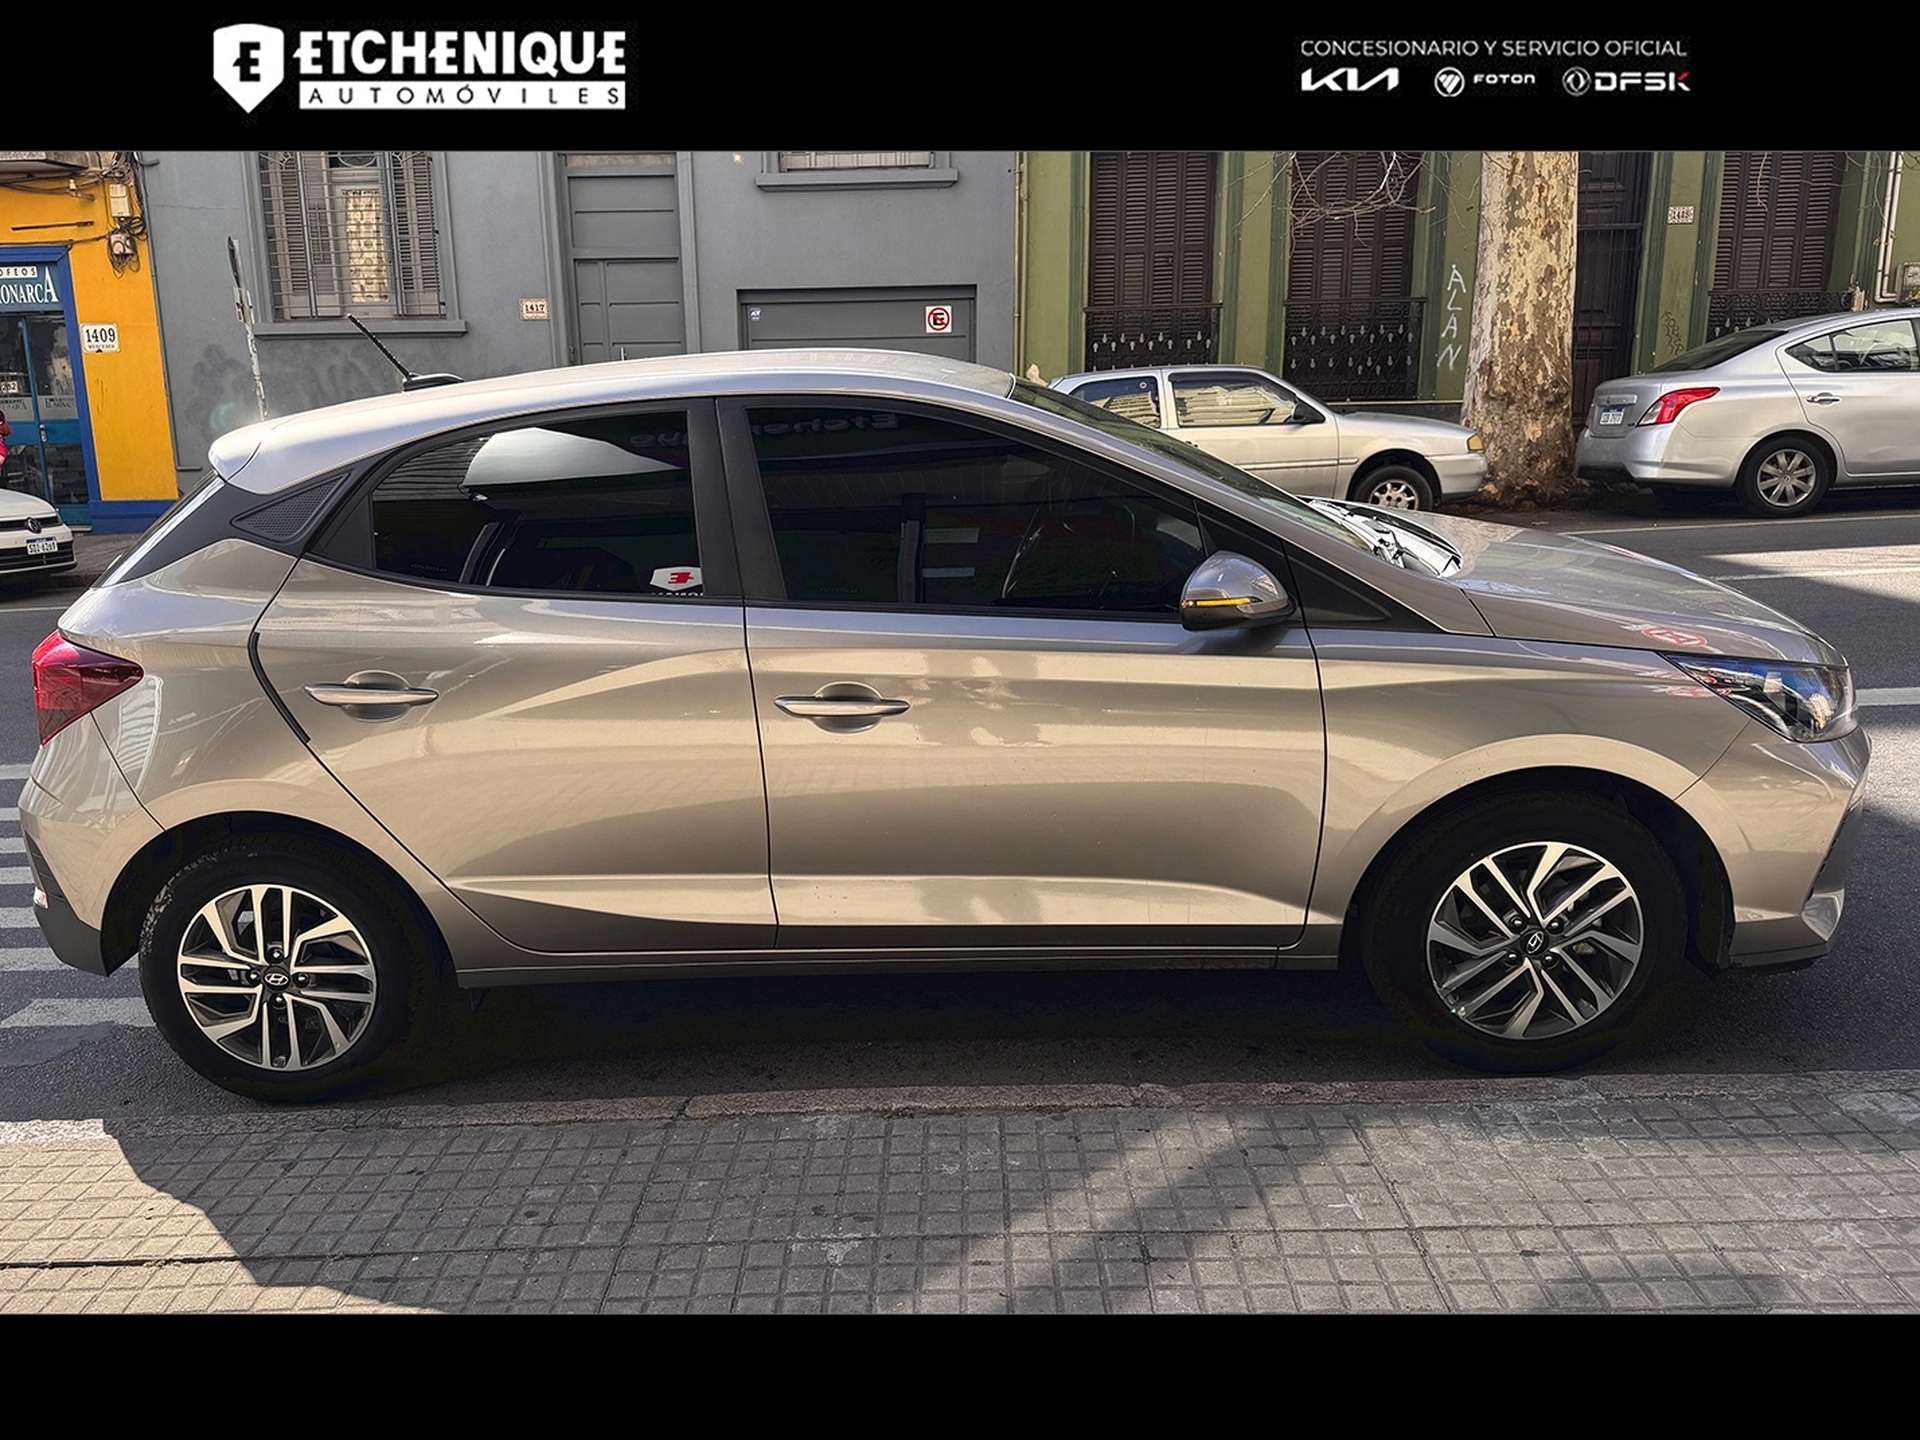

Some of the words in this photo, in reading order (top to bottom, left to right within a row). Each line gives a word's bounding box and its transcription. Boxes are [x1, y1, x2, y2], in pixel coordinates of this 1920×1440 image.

[0, 266, 59, 305] ONARCA
[525, 304, 545, 312] 1417
[1436, 264, 1467, 372] ALAN
[85, 327, 116, 343] 1409
